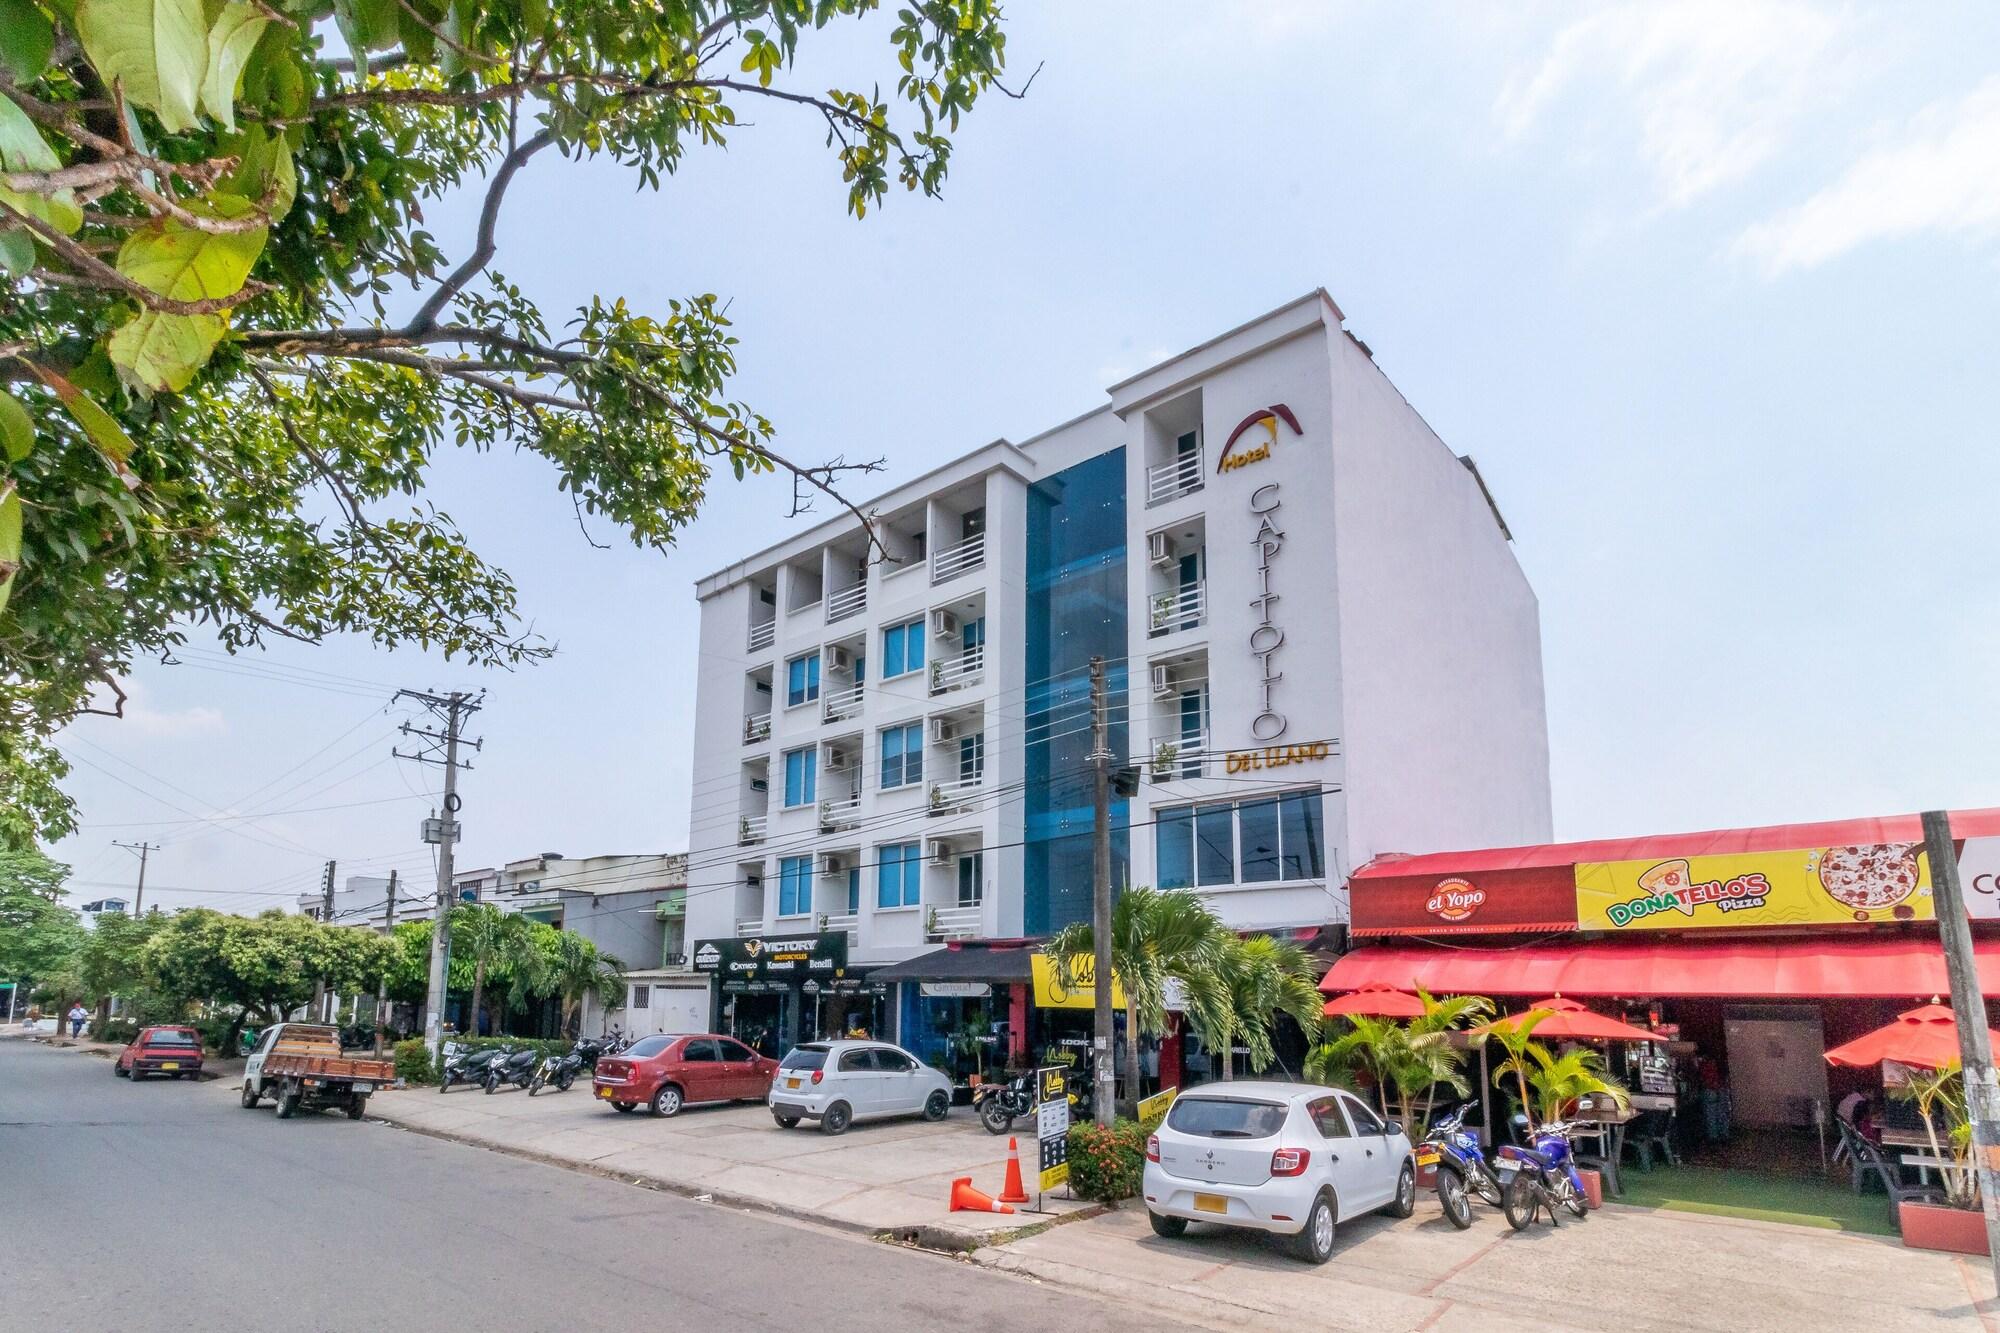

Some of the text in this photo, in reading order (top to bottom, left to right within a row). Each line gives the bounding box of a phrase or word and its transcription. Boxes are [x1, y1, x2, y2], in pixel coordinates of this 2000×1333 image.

[1222, 441, 1271, 473] Hotel
[1249, 482, 1287, 741] CAPITOLIO
[1428, 892, 1483, 910] el Yopo
[1607, 873, 1770, 926] DONATELLO'S
[1718, 896, 1765, 912] Pizza
[762, 940, 818, 952] VICTORY
[809, 959, 832, 968] Benelli
